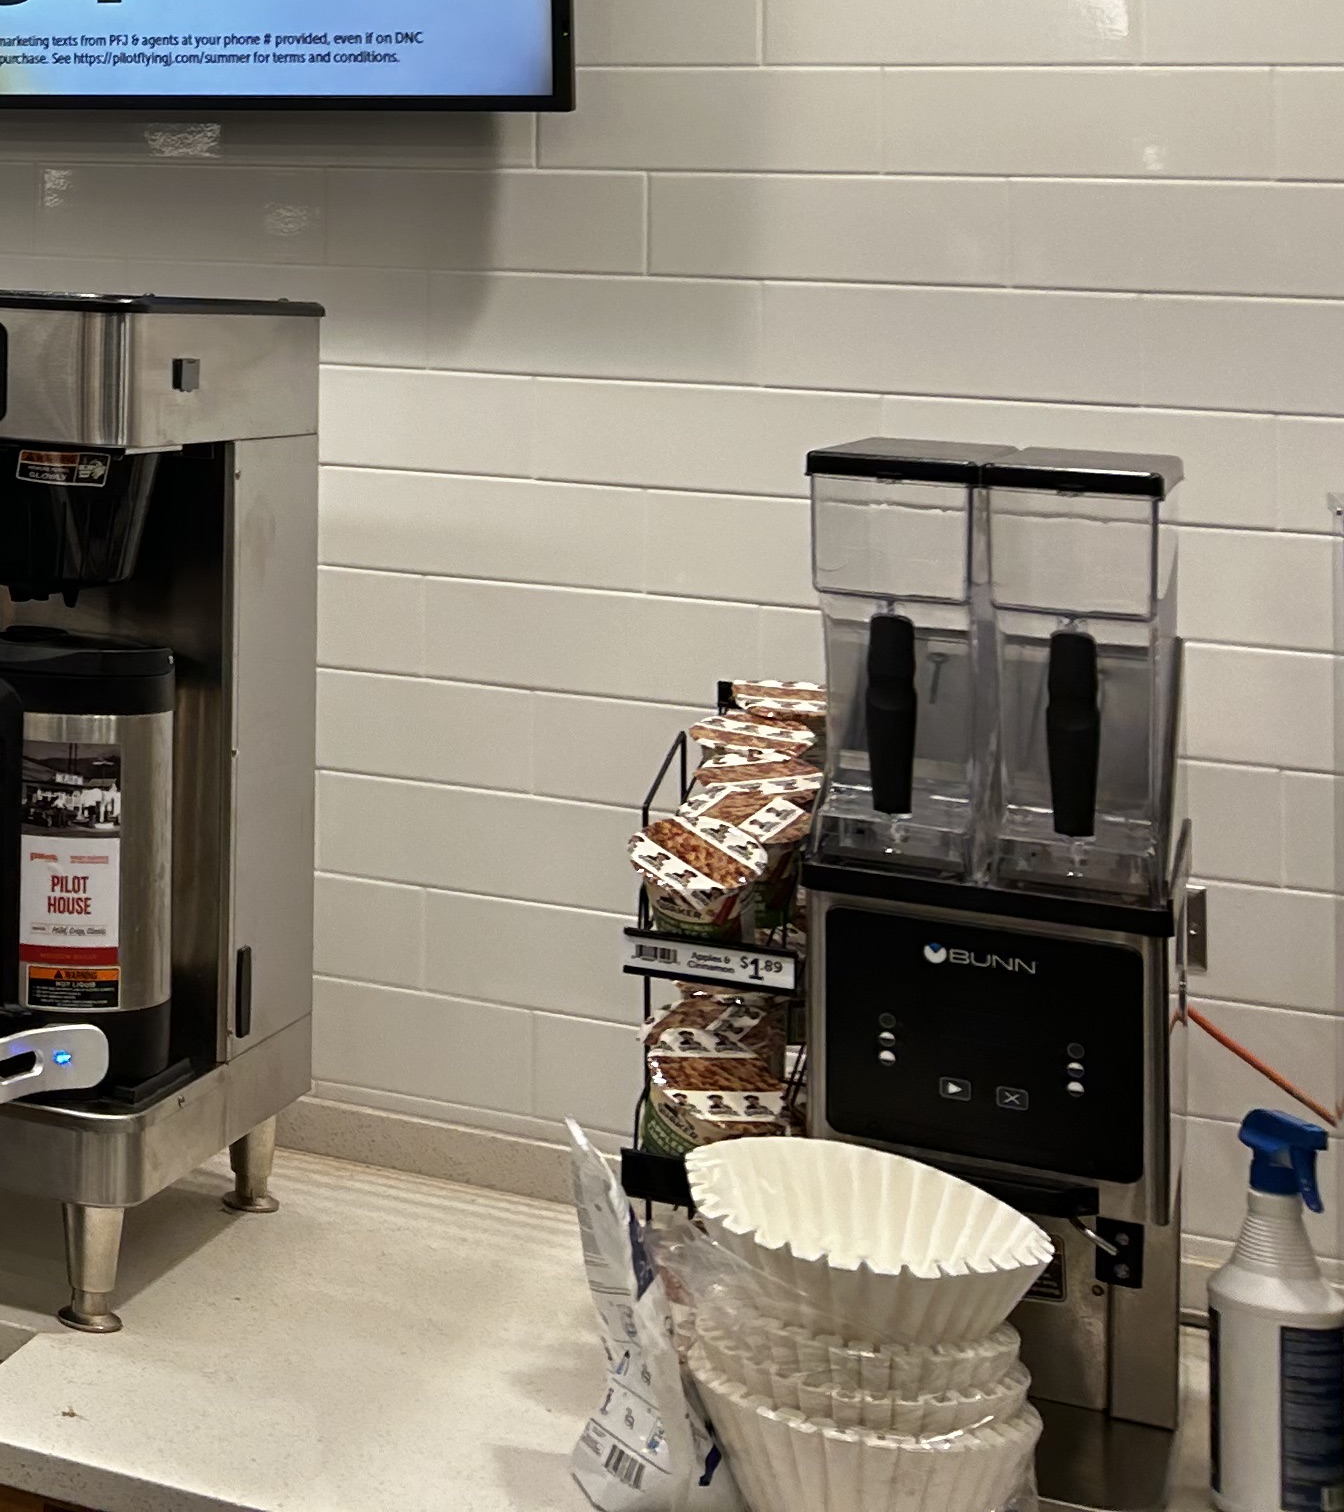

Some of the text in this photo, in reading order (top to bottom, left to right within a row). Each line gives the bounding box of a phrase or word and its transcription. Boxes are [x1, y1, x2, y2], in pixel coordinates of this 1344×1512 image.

[52, 36, 78, 47] texts
[81, 35, 106, 47] from
[109, 35, 128, 46] PFJ
[141, 36, 179, 49] agents
[182, 36, 192, 46] at
[194, 37, 221, 48] your
[223, 33, 260, 48] phone
[275, 32, 331, 48] provided,
[334, 34, 362, 44] even
[365, 32, 374, 44] if
[376, 34, 392, 44] on
[395, 31, 424, 44] DNC
[0, 53, 49, 67] purchase.
[52, 53, 71, 64] See
[253, 52, 270, 63] for
[272, 52, 305, 63] terms
[308, 52, 331, 63] and
[333, 50, 400, 63] conditions.
[51, 875, 89, 895] PILOT
[47, 896, 92, 915] HOUSE
[691, 952, 722, 964] Apples
[949, 947, 1038, 975] BUNN
[64, 971, 98, 980] WARNING
[687, 960, 735, 974] Cinnamon
